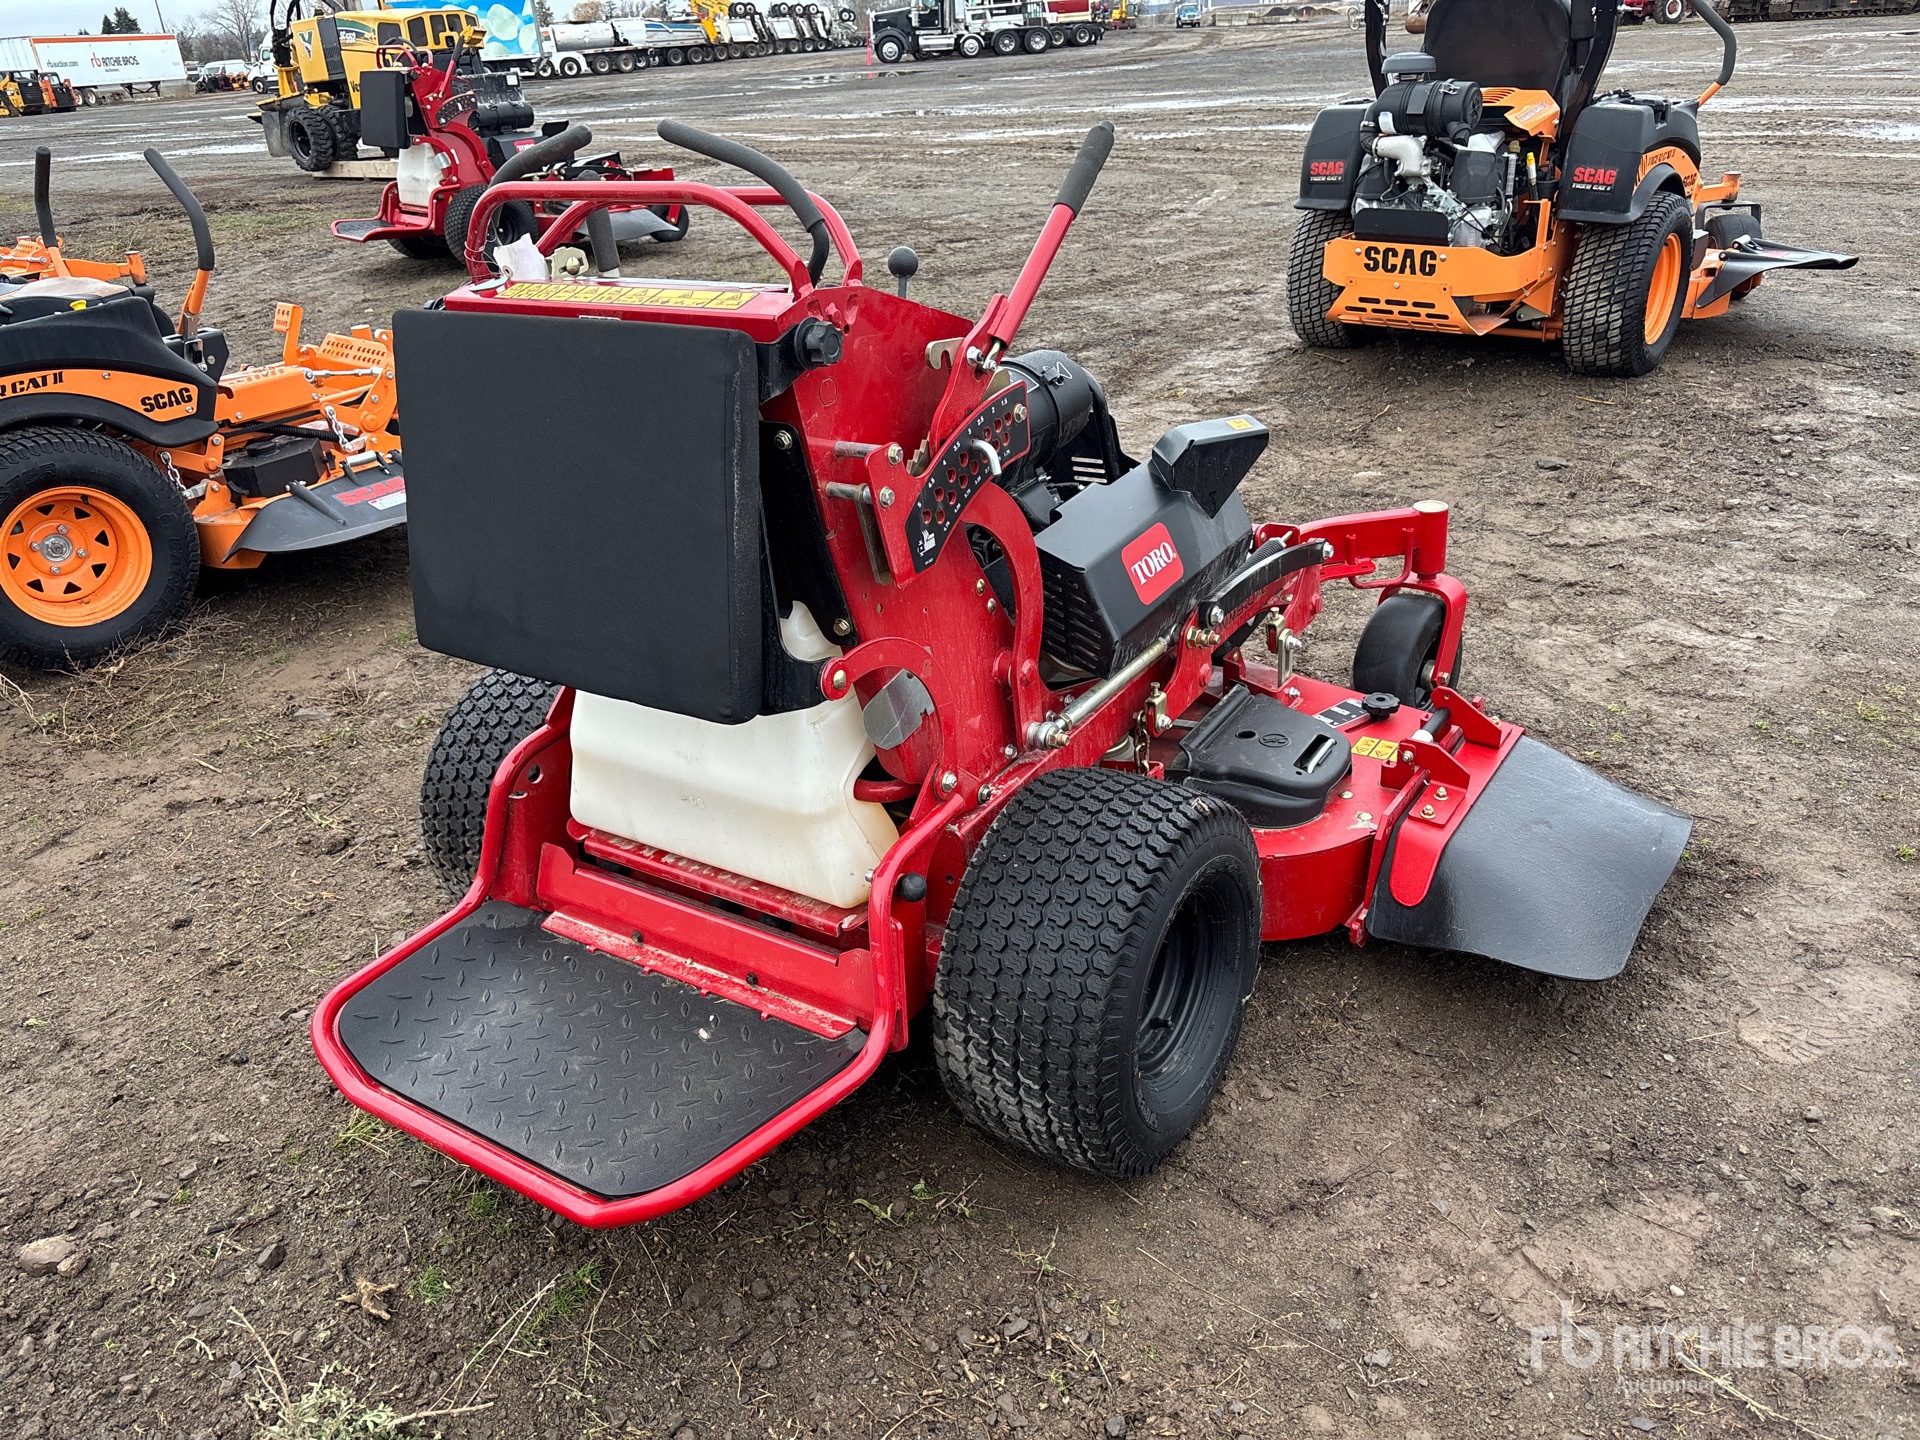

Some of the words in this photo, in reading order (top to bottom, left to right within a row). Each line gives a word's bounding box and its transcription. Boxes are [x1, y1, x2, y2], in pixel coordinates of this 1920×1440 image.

[101, 57, 122, 66] RITCHIE
[1310, 161, 1344, 175] SCAG
[1573, 166, 1617, 184] SCAG
[1363, 246, 1437, 277] SCAG
[11, 374, 51, 394] CAT
[140, 387, 193, 413] SCAG
[976, 416, 984, 426] 2.5
[953, 441, 961, 451] 3.5
[336, 477, 405, 505] SCAG
[1131, 541, 1174, 586] TORO
